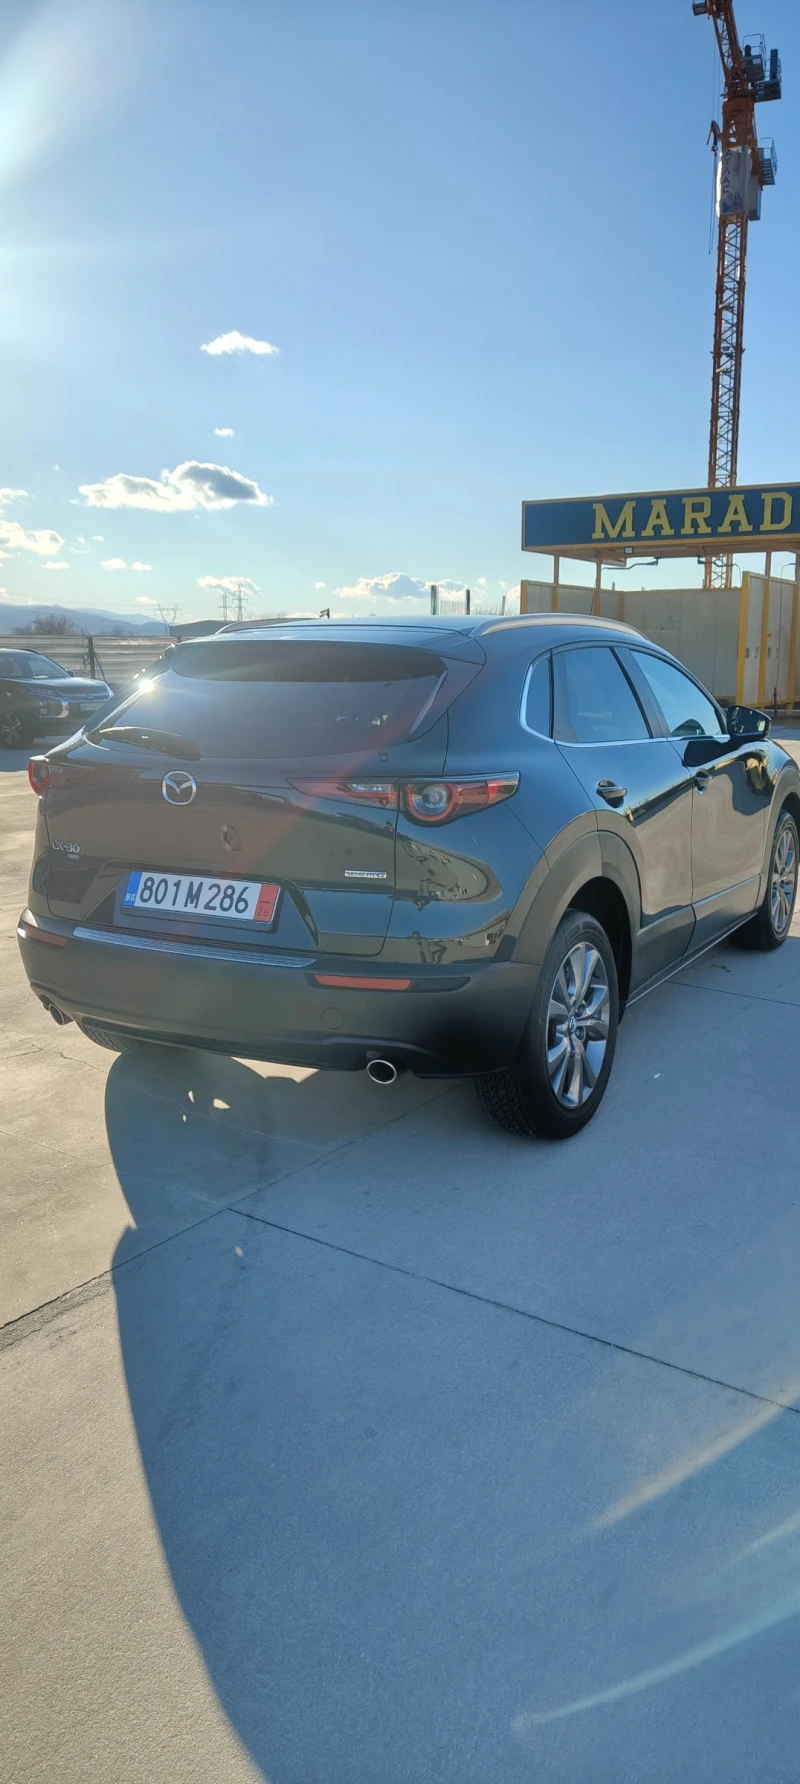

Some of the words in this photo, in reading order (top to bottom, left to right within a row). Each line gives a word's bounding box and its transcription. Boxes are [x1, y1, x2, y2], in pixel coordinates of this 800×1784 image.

[592, 492, 792, 539] MARAD
[125, 893, 136, 902] BG
[139, 876, 250, 915] 801M286
[256, 907, 269, 918] 26
